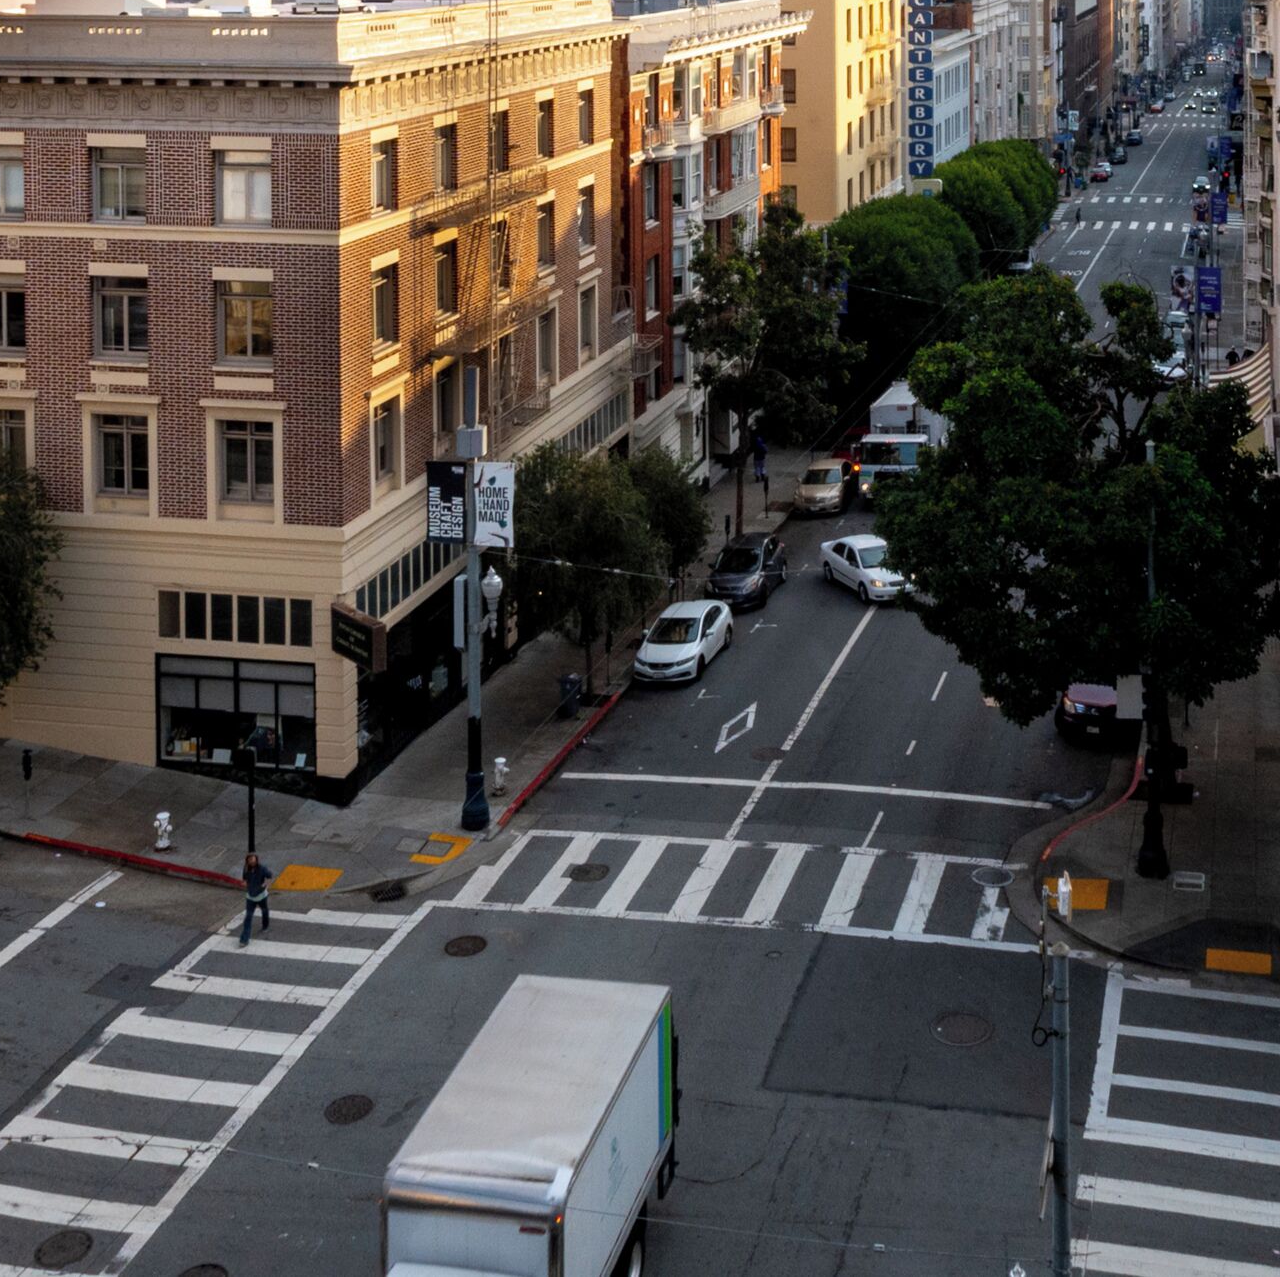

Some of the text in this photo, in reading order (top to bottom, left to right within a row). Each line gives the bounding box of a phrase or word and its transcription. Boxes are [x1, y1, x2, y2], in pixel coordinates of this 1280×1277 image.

[478, 487, 508, 499] HOME
[482, 499, 510, 511] HAND
[429, 486, 441, 537] MUSEUM
[440, 501, 452, 538] CRAFT
[452, 496, 464, 539] DESIGN
[478, 511, 508, 523] MADE
